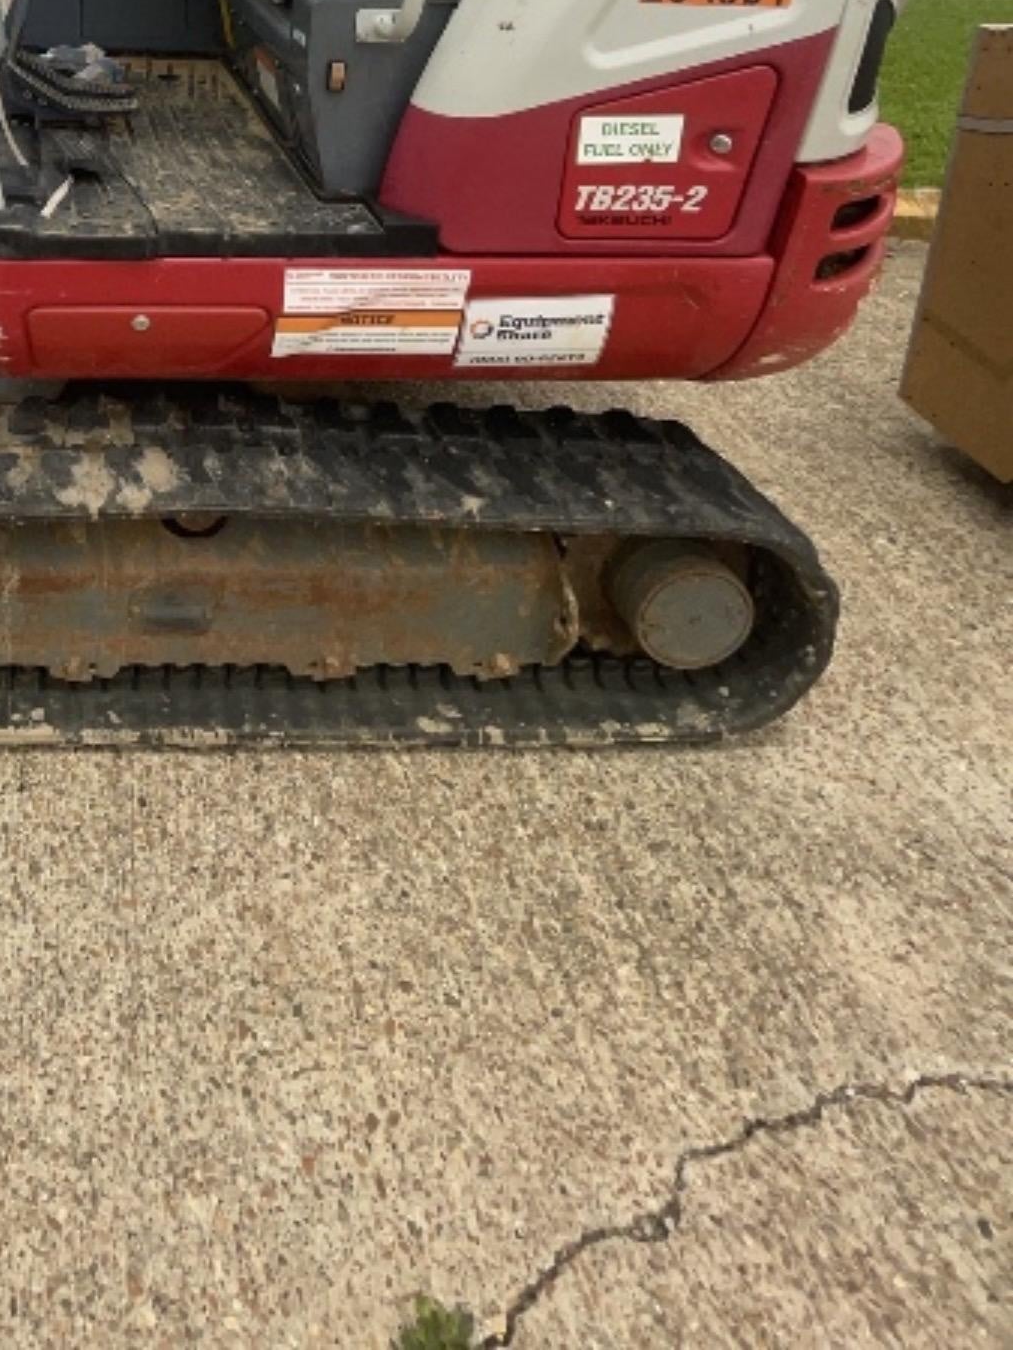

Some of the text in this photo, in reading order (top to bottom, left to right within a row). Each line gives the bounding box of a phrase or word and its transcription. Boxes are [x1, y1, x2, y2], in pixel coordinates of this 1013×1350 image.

[601, 122, 659, 136] DIESEL
[584, 142, 673, 157] FUEL ONLY
[575, 185, 708, 211] TB235-2
